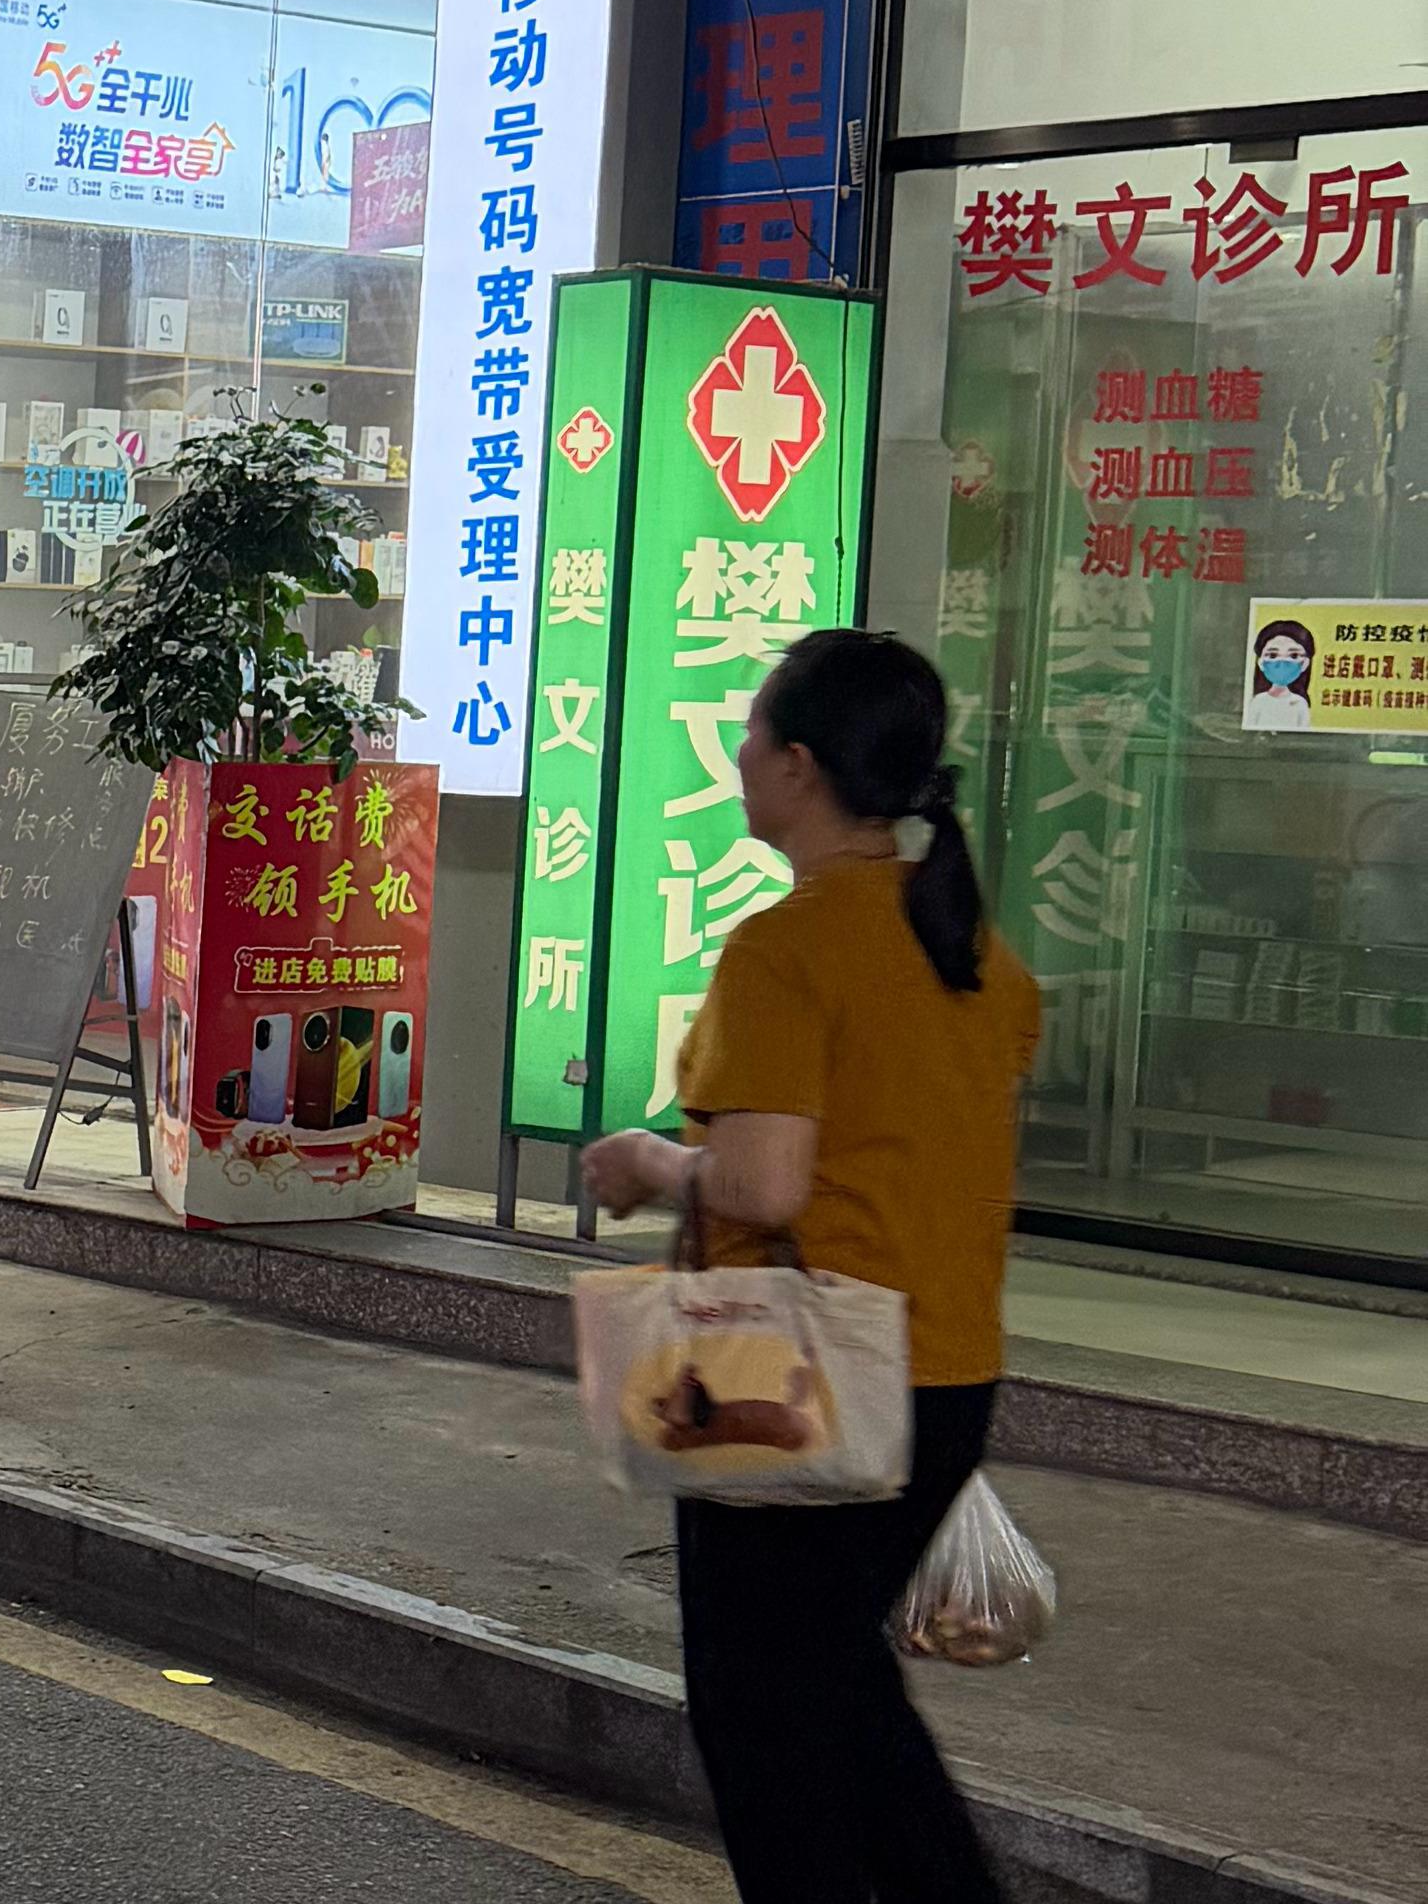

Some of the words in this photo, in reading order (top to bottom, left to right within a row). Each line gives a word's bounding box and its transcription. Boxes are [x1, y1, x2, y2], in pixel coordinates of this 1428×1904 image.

[53, 121, 237, 182] 数智全家享
[958, 160, 1411, 297] 樊文诊所
[1093, 366, 1265, 425] 测血糖
[24, 465, 127, 502] 空调开放
[1088, 445, 1257, 500] 测血压
[1080, 522, 1249, 585] 测体温
[525, 547, 607, 1013] 樊文诊所
[221, 782, 396, 850] 交话费
[645, 535, 817, 1120] 樊文诊
[243, 862, 419, 924] 领手机
[251, 953, 399, 988] 进店免费贴膜
